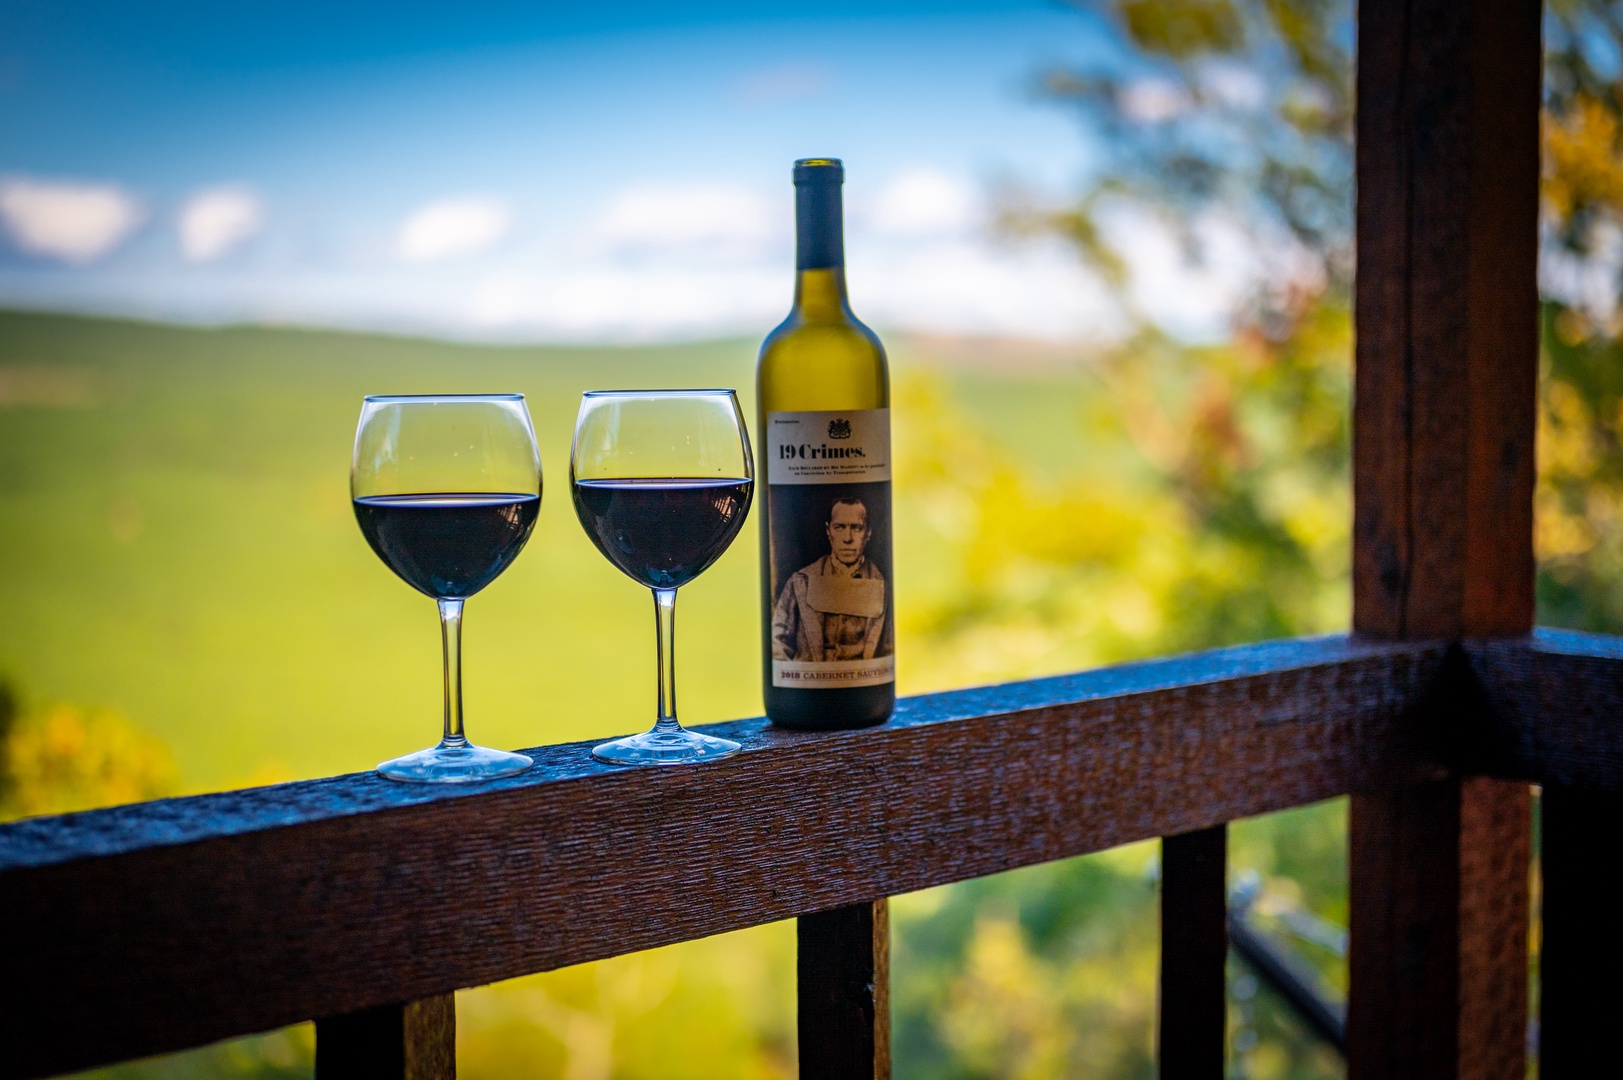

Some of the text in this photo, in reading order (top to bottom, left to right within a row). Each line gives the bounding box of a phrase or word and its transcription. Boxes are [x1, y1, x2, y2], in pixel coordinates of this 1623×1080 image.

[780, 444, 866, 459] 19 Crimes.
[781, 671, 800, 679] 2018
[803, 671, 855, 680] CABERNET
